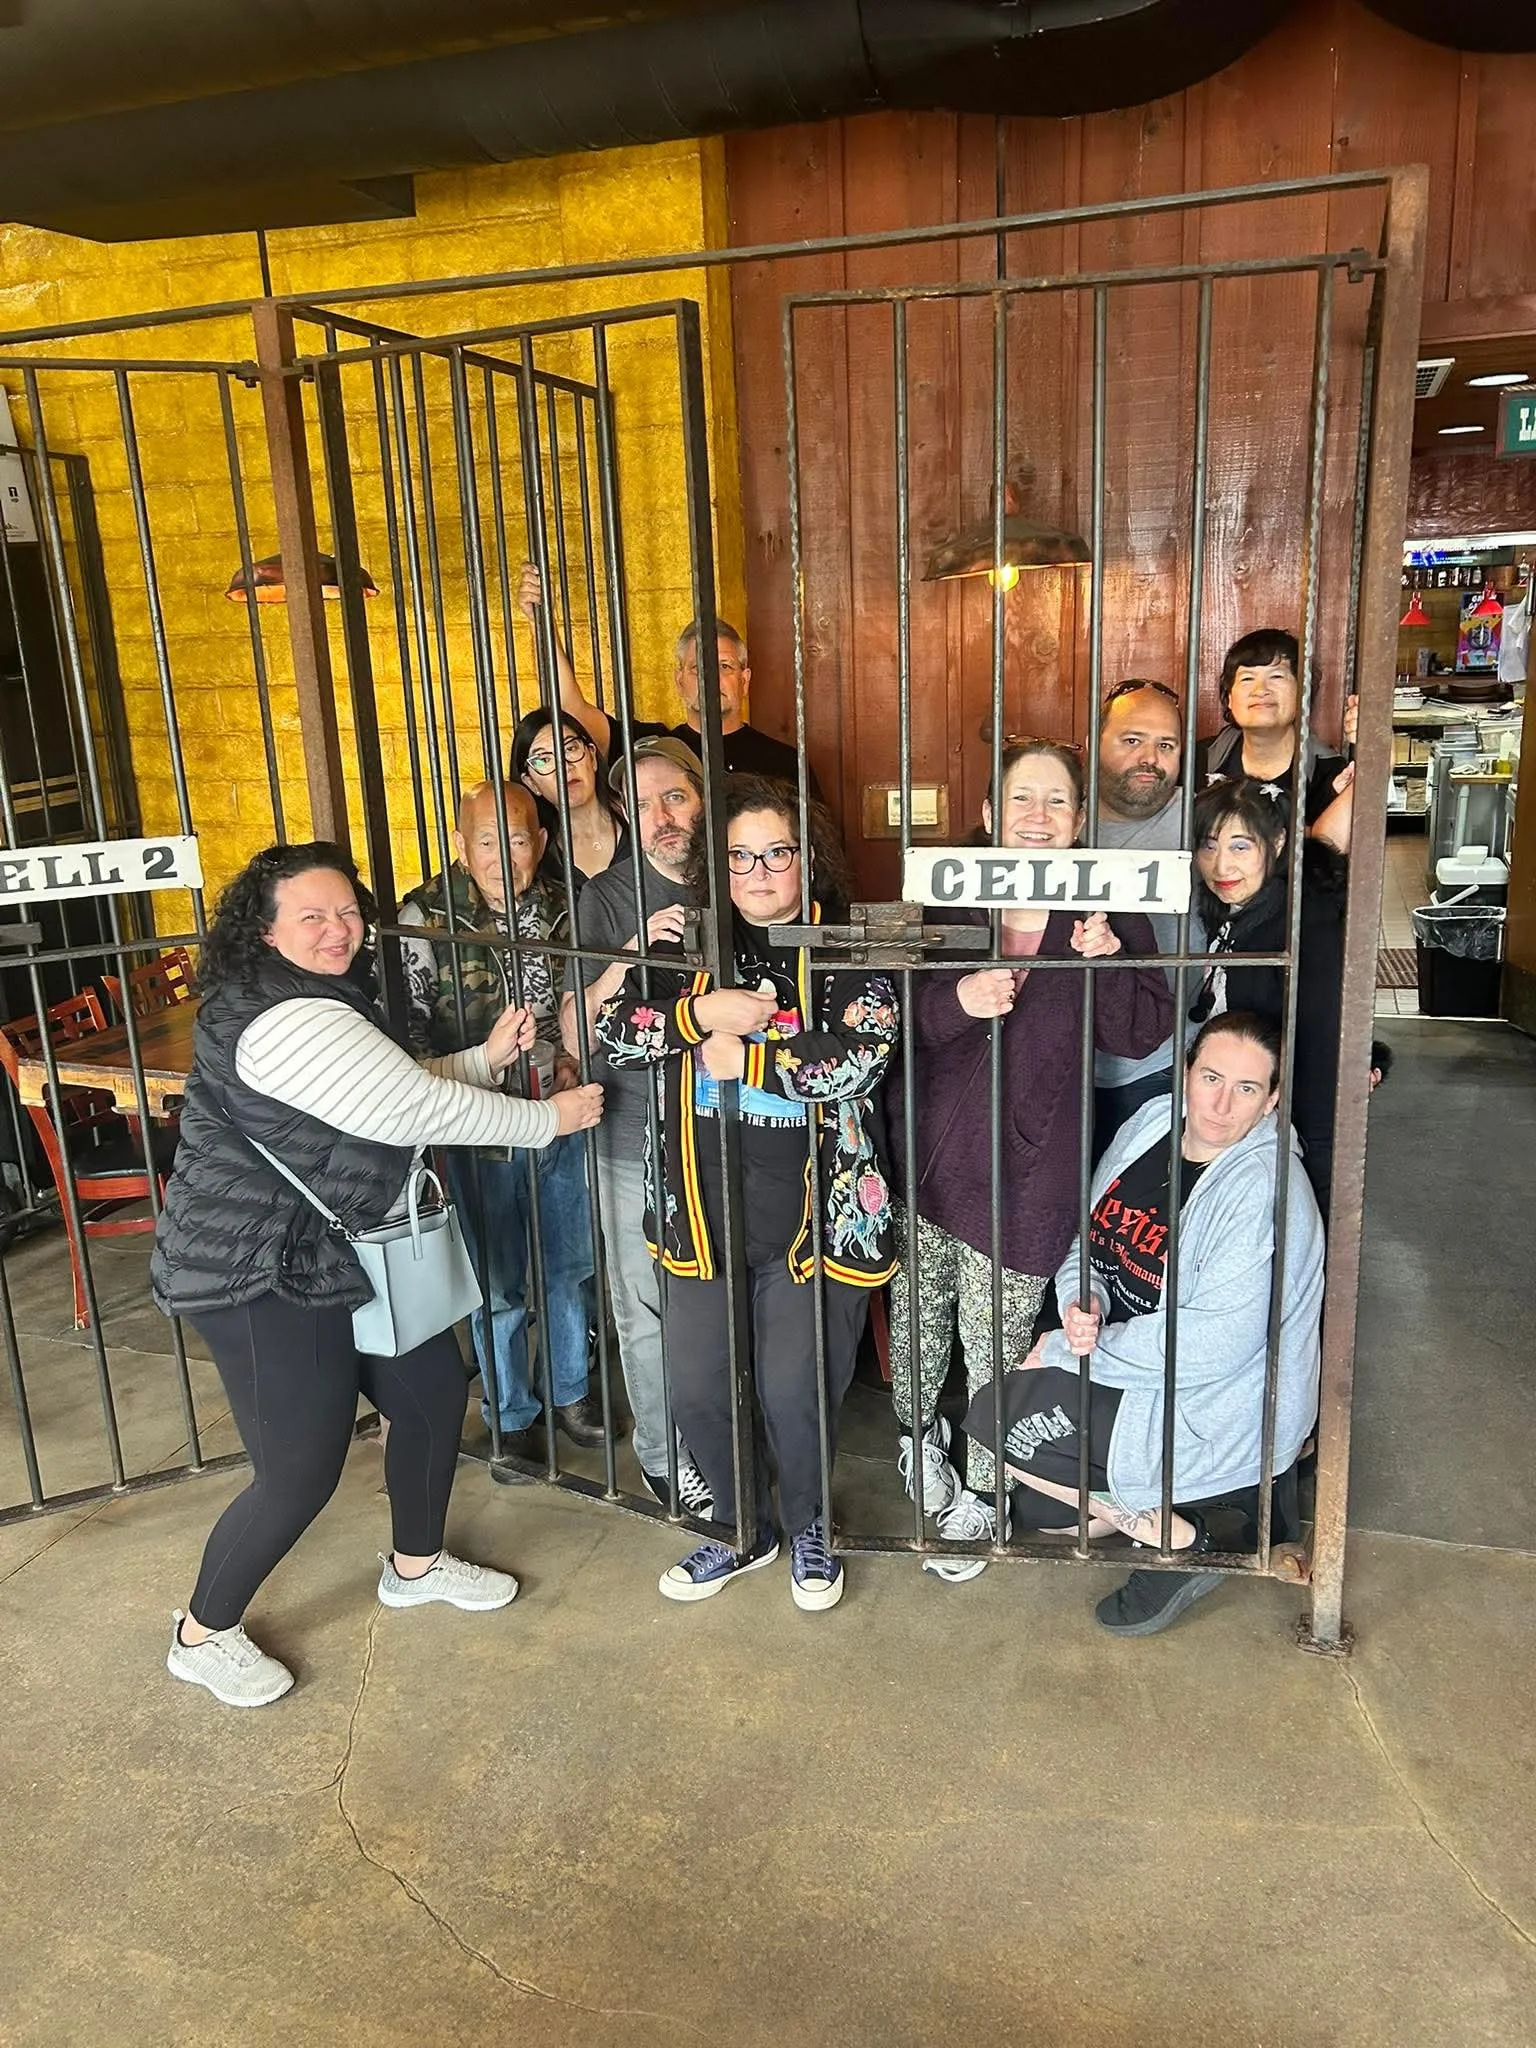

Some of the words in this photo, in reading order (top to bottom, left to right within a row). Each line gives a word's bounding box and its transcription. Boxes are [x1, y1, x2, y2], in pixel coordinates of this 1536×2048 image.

[142, 846, 178, 880] 2
[931, 858, 1111, 901] CELL
[1138, 860, 1163, 902] 1
[747, 1113, 765, 1127] THE
[770, 1116, 807, 1128] STATES
